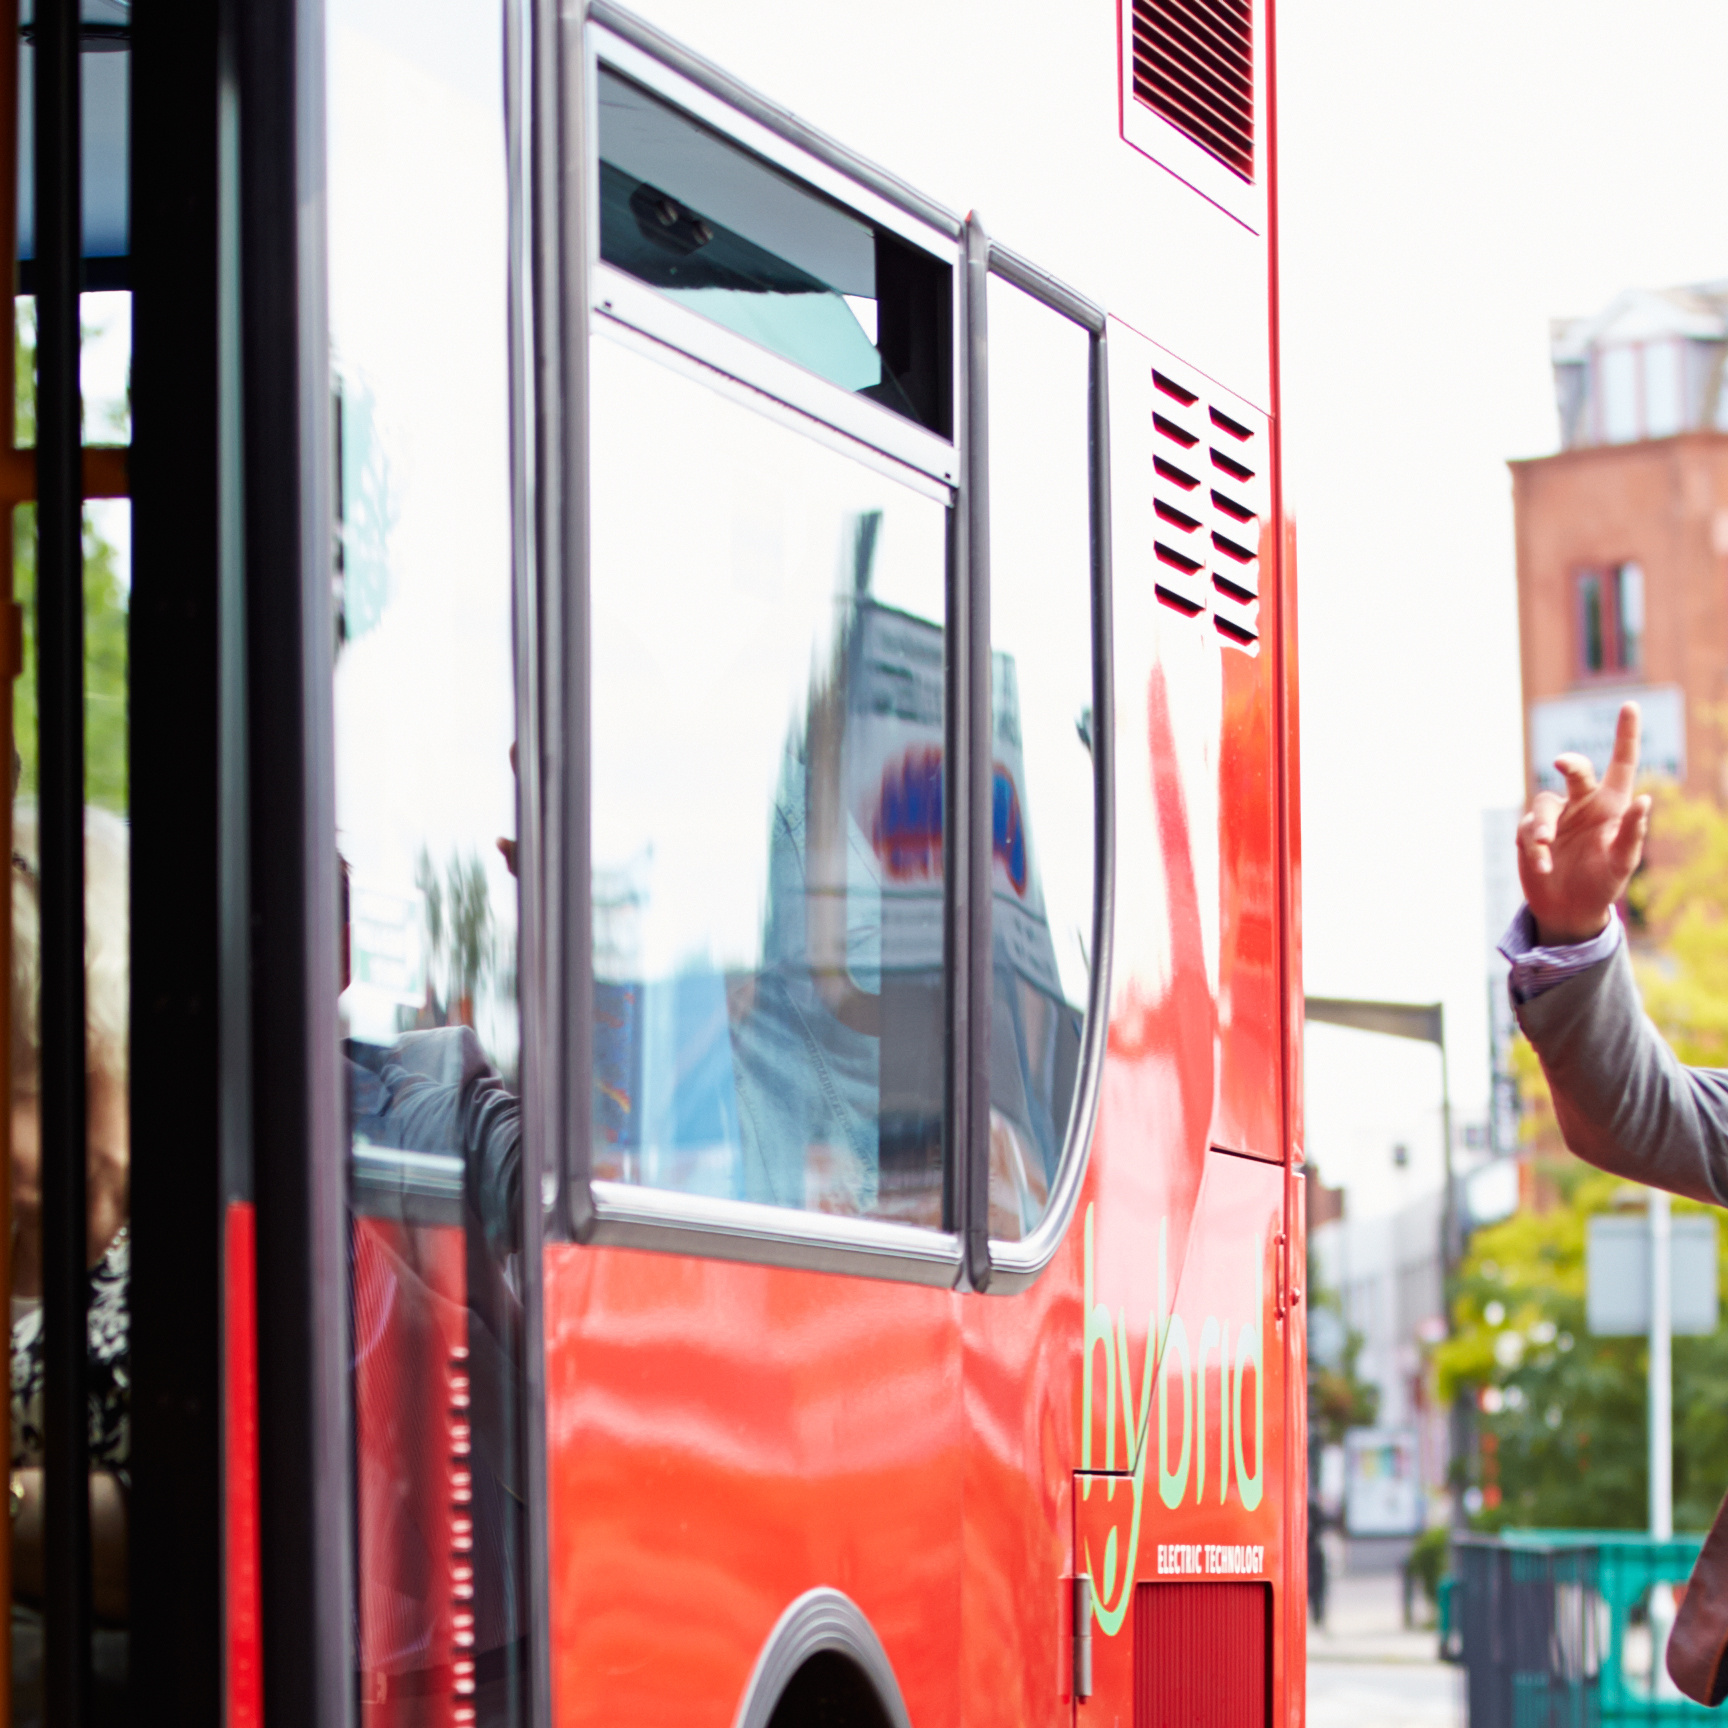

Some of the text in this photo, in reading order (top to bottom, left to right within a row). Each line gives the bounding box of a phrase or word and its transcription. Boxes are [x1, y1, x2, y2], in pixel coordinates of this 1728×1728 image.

[1082, 1202, 1264, 1637] hybrid
[1157, 1544, 1264, 1574] ELECTRIC TECHNOLOGY
